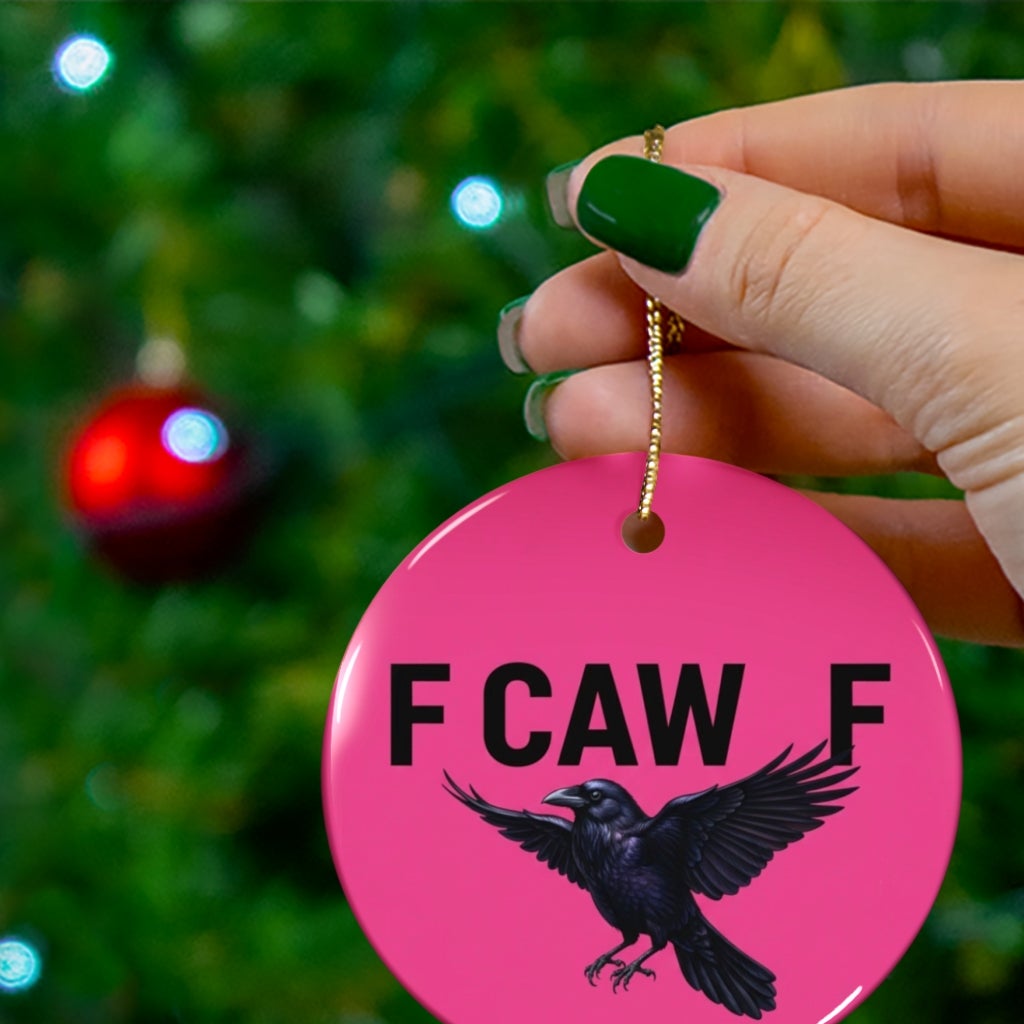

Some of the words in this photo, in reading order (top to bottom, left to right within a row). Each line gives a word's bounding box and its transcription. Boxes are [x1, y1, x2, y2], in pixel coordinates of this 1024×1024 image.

[391, 664, 450, 766] F
[483, 662, 745, 767] CAW
[830, 664, 891, 766] F
